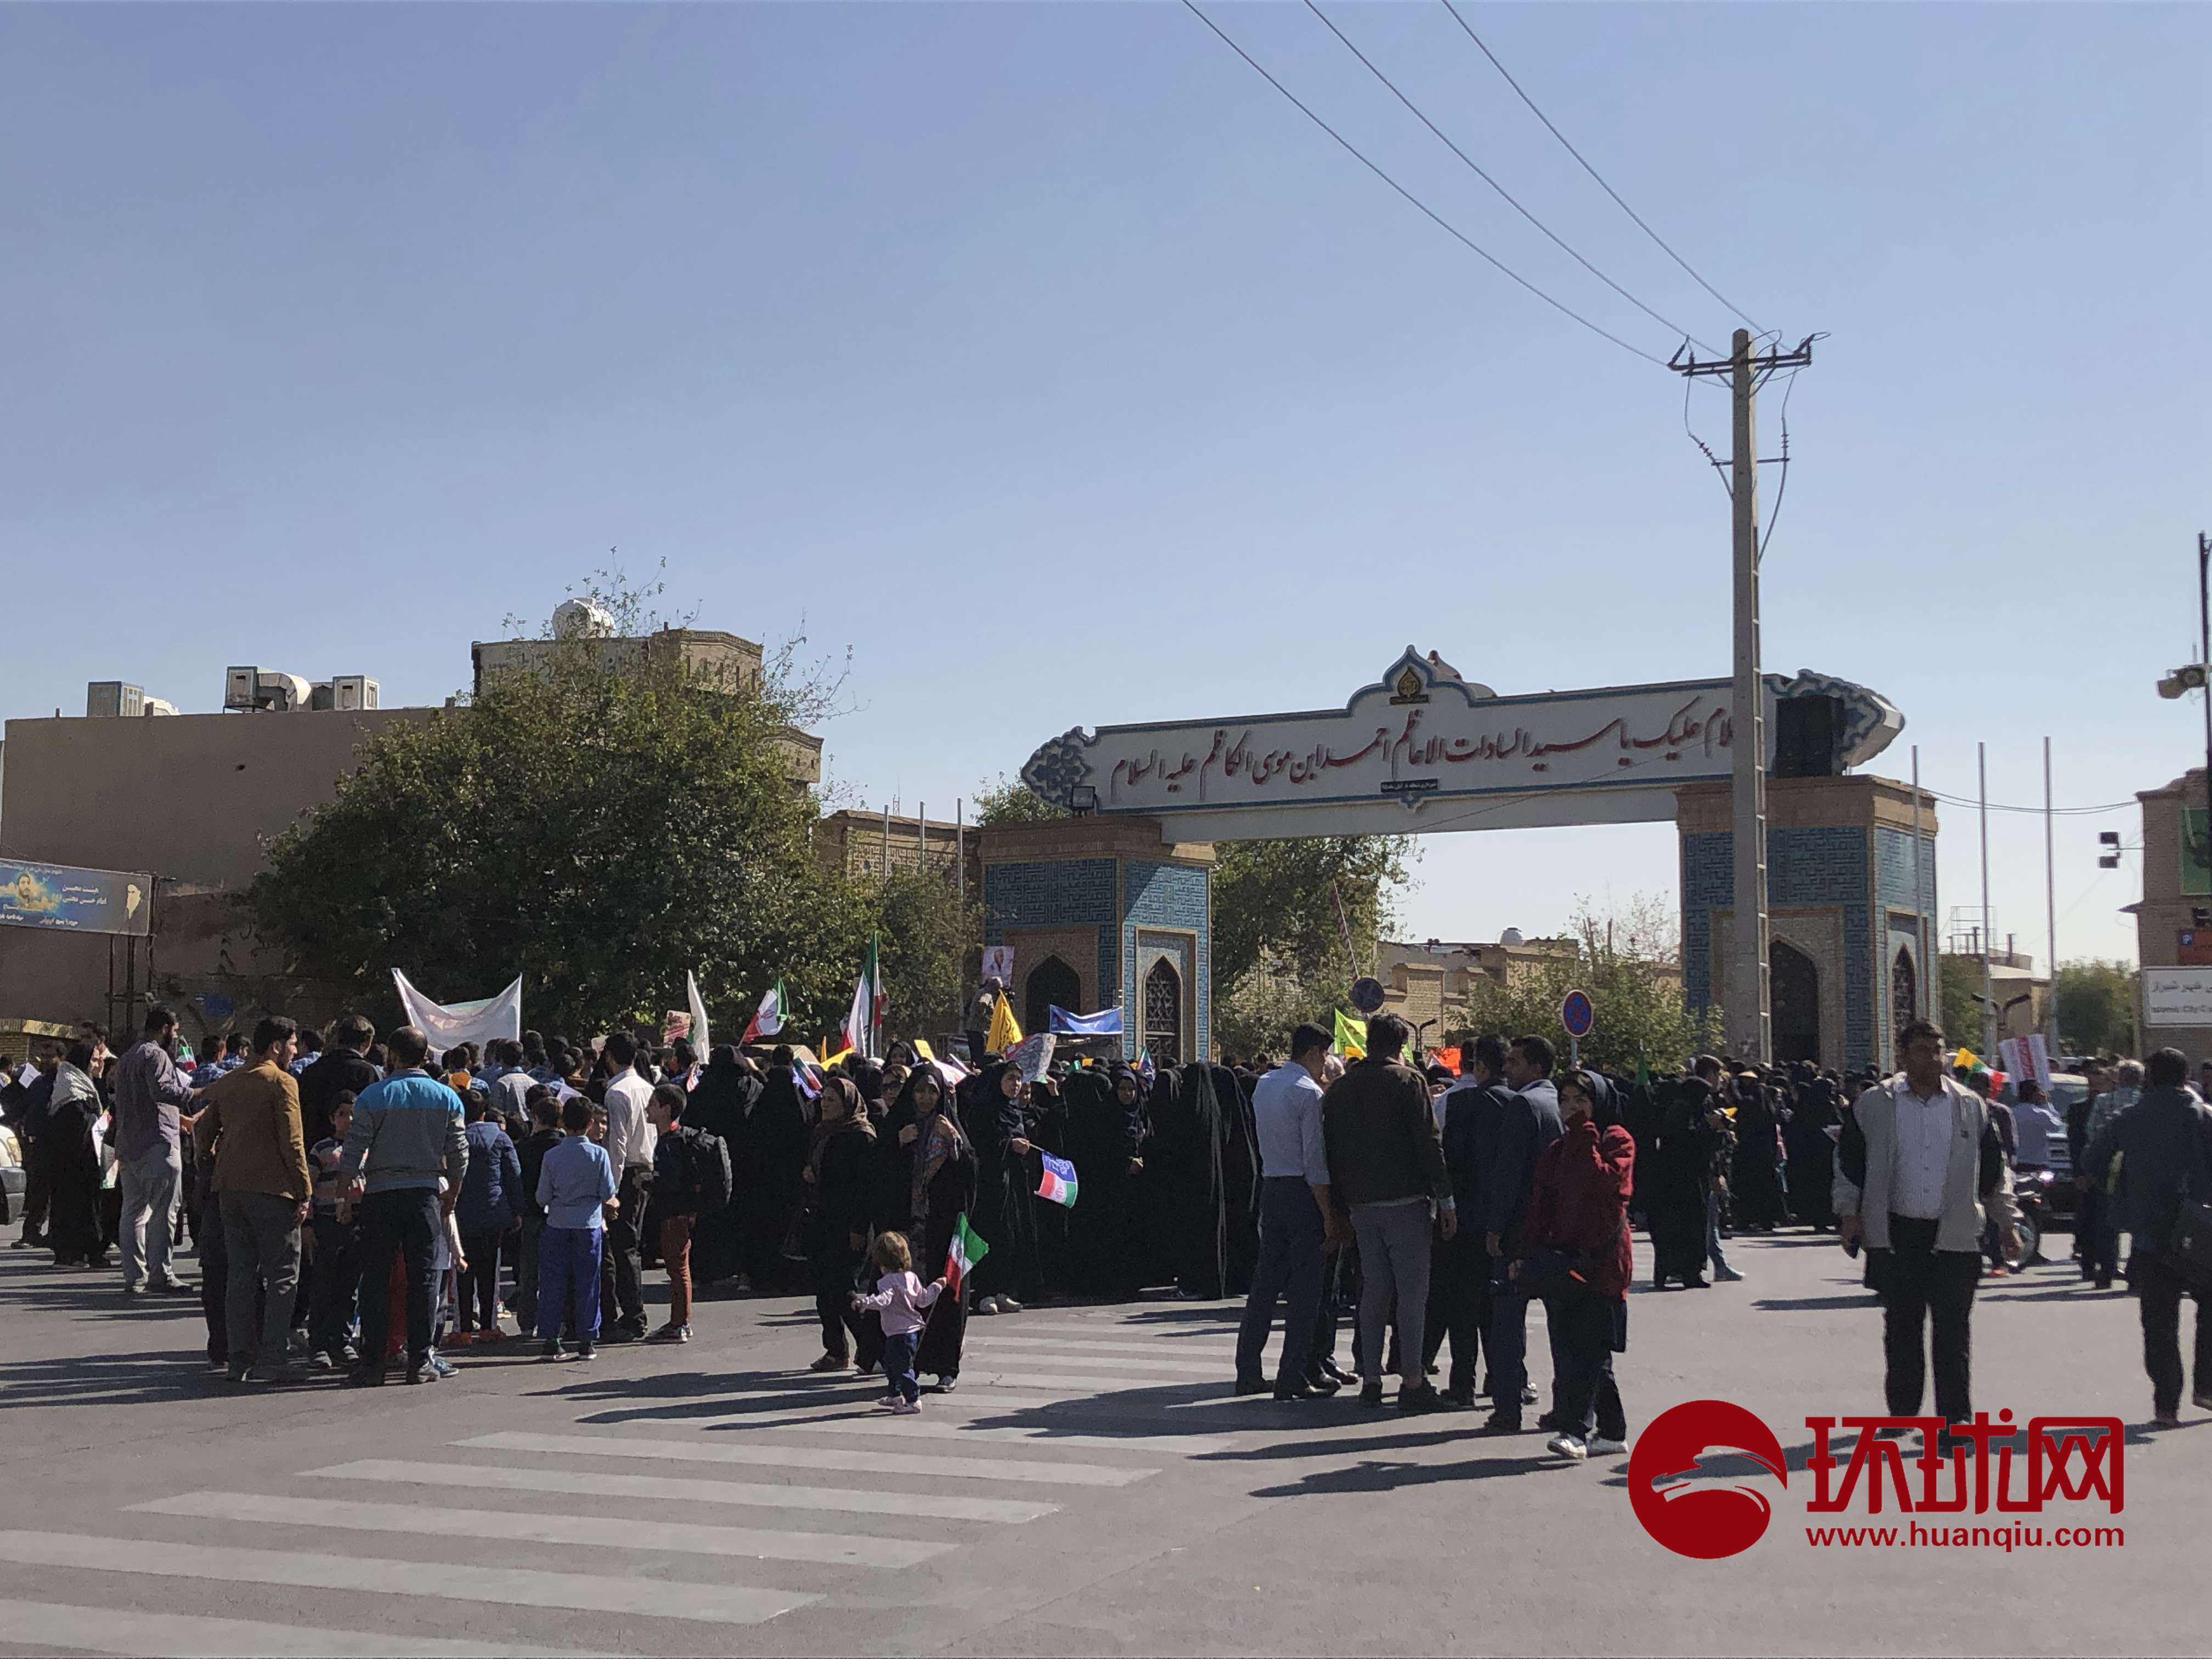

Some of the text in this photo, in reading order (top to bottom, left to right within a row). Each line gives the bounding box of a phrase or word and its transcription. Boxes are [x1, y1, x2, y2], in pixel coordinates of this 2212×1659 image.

[1111, 748, 1165, 804] السلام
[1165, 752, 1197, 793] علیه
[1199, 729, 1252, 802] الکاظم
